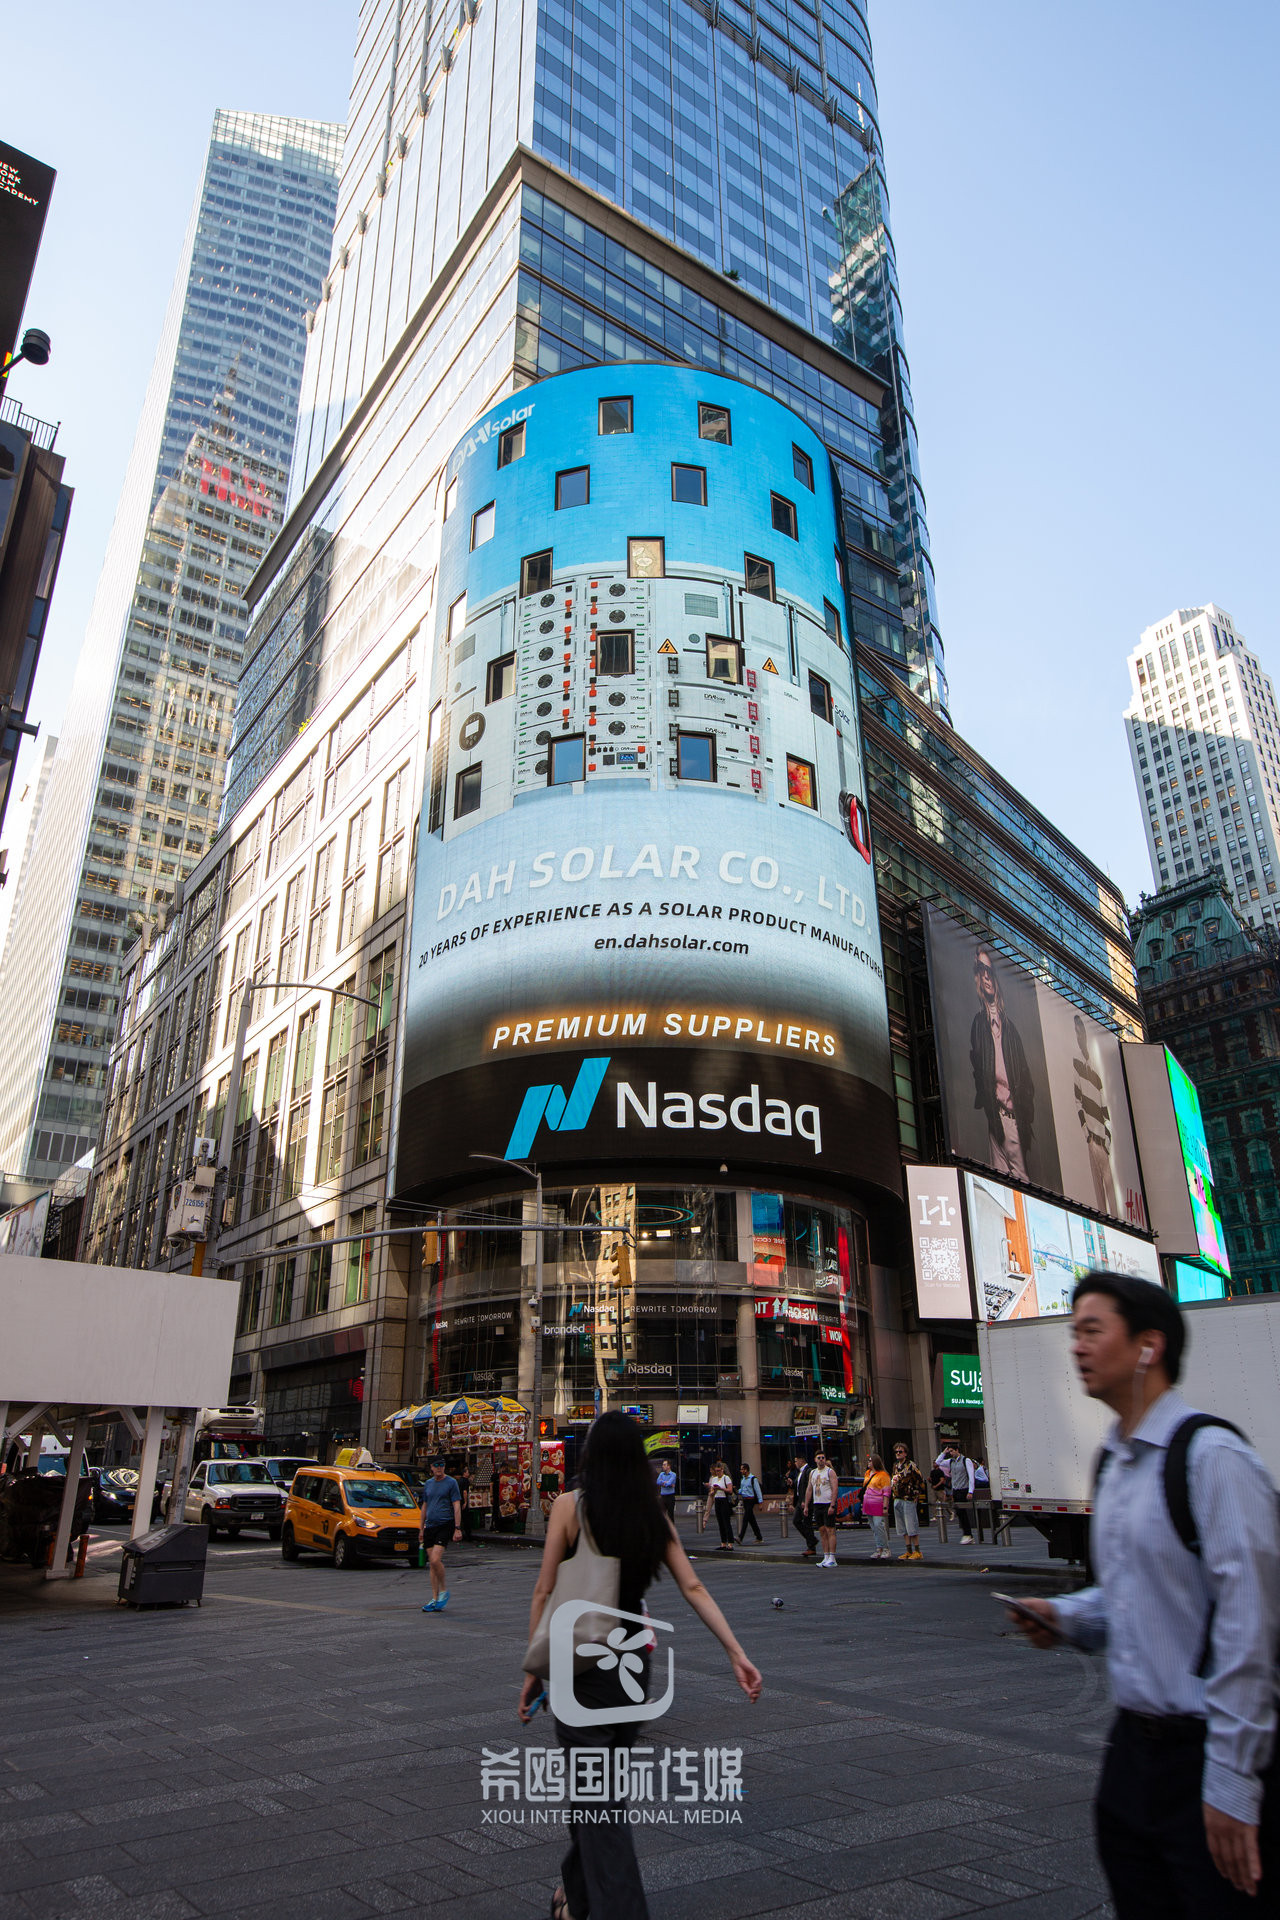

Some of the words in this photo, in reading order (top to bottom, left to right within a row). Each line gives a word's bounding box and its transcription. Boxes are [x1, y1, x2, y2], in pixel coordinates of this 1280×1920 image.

[0, 175, 16, 188] LM
[436, 860, 517, 922] DAH
[529, 844, 700, 889] SOLAR
[718, 850, 805, 904] CO.,
[817, 874, 873, 936] LTD.
[418, 951, 429, 969] 20
[430, 931, 467, 960] YEARS
[470, 923, 490, 941] OF
[492, 903, 602, 934] EXPERIENCE
[606, 902, 634, 916] AS
[638, 902, 653, 916] A
[658, 902, 722, 919] SOLAR
[728, 907, 807, 935] PRODUCT
[594, 933, 749, 955] en.dahsolar.com
[492, 1013, 648, 1050] PREMIUM
[662, 1012, 837, 1057] SUPPLIERS
[615, 1081, 823, 1155] Nasdaq
[1125, 1187, 1145, 1228] H&M
[477, 1311, 513, 1323] TOMORROW
[583, 1304, 615, 1314] Nasdaq
[629, 1305, 667, 1313] REWRITE
[671, 1305, 718, 1314] TOMORROW
[627, 1363, 673, 1376] Nasdaq
